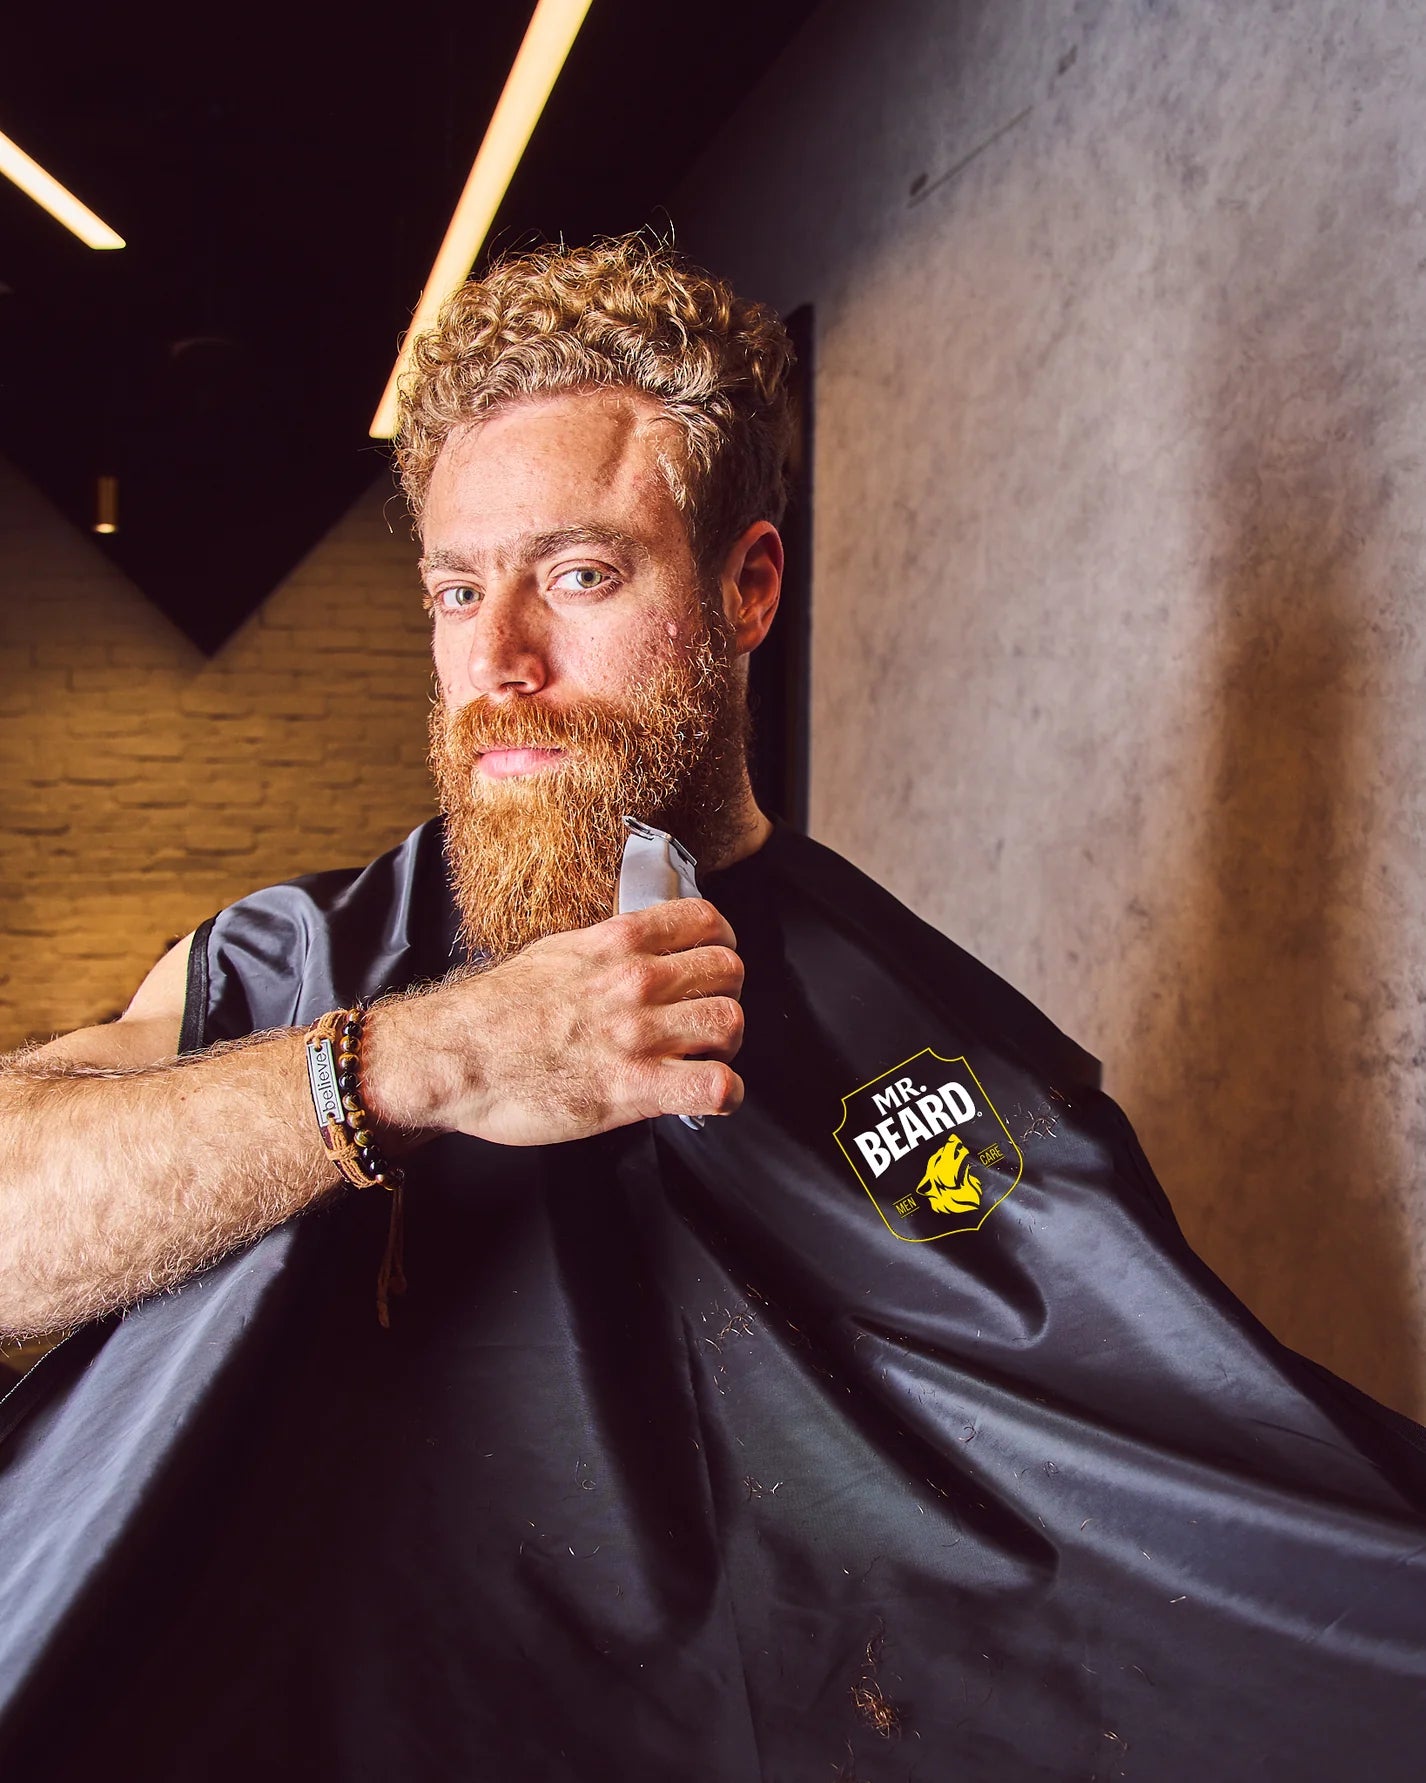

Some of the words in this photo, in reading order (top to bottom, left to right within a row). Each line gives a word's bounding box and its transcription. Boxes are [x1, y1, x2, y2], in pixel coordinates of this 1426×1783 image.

[316, 1052, 336, 1113] believe
[871, 1077, 928, 1117] MR.
[895, 1197, 917, 1215] MEN
[979, 1145, 1004, 1166] CARE
